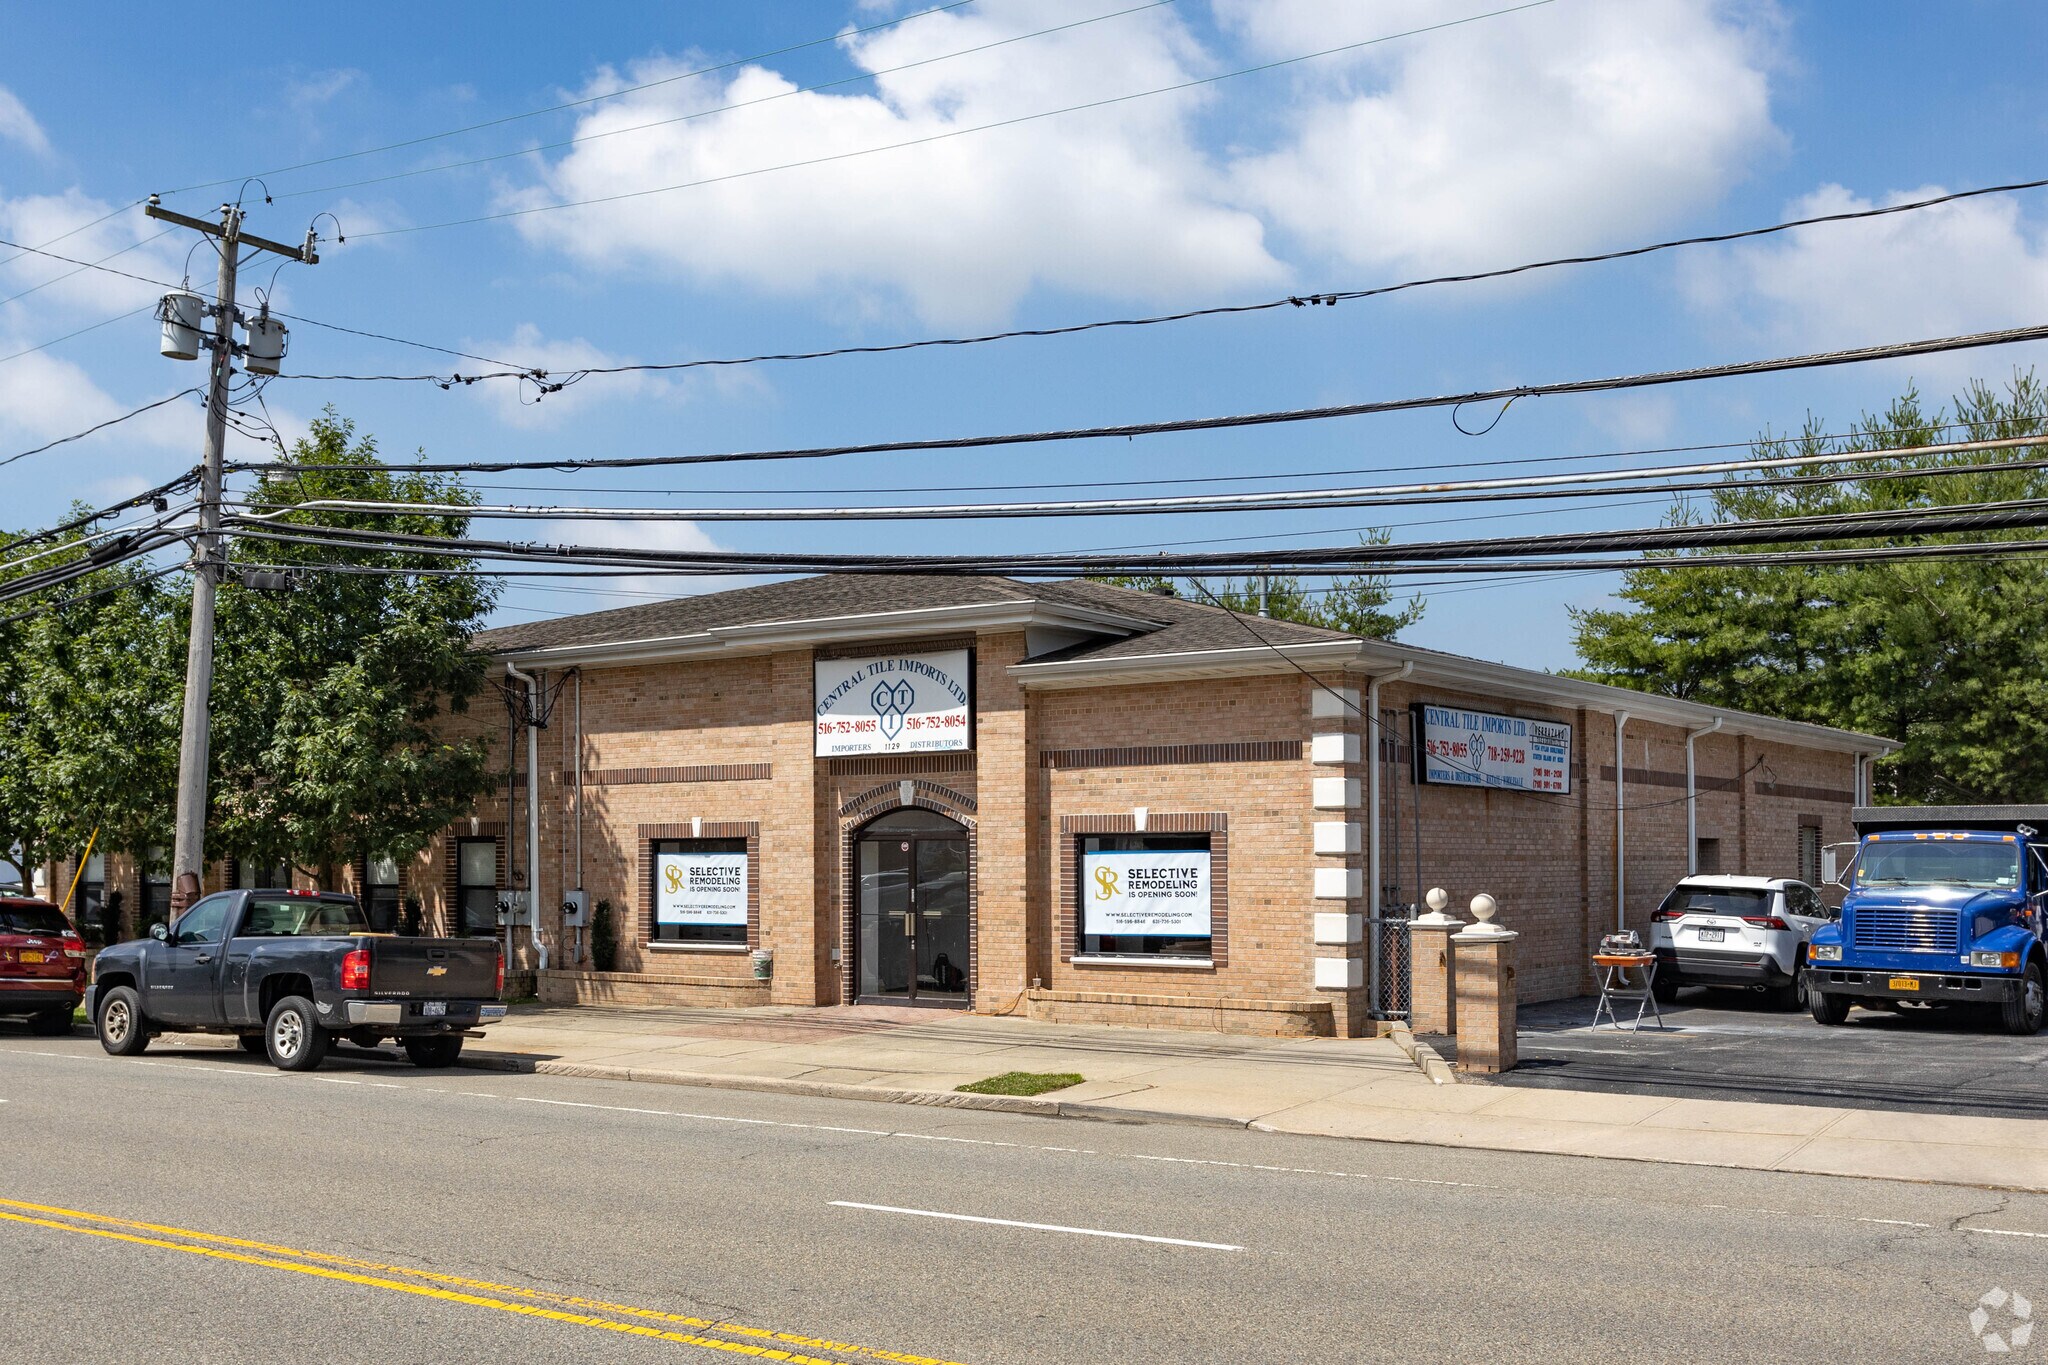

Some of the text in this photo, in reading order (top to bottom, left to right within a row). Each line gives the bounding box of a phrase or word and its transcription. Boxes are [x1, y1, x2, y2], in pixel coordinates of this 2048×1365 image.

[817, 658, 967, 717] CENTRAL TILE IMPORTS LTD.
[876, 689, 909, 707] C T
[818, 719, 877, 735] 516-752-8055
[906, 714, 966, 730] 516-752-8054
[1425, 708, 1527, 736] CENTRAL TILE IMPORTS LTD.
[831, 744, 872, 752] IMPORTERS
[910, 739, 963, 749] DISTRIBUTORS
[1427, 739, 1468, 758] 516-752-8055
[1487, 746, 1525, 764] 718-259-9228
[689, 867, 741, 876] SELECTIVE
[1128, 868, 1198, 879] SELECTIVE
[1128, 880, 1198, 889] REMODELING
